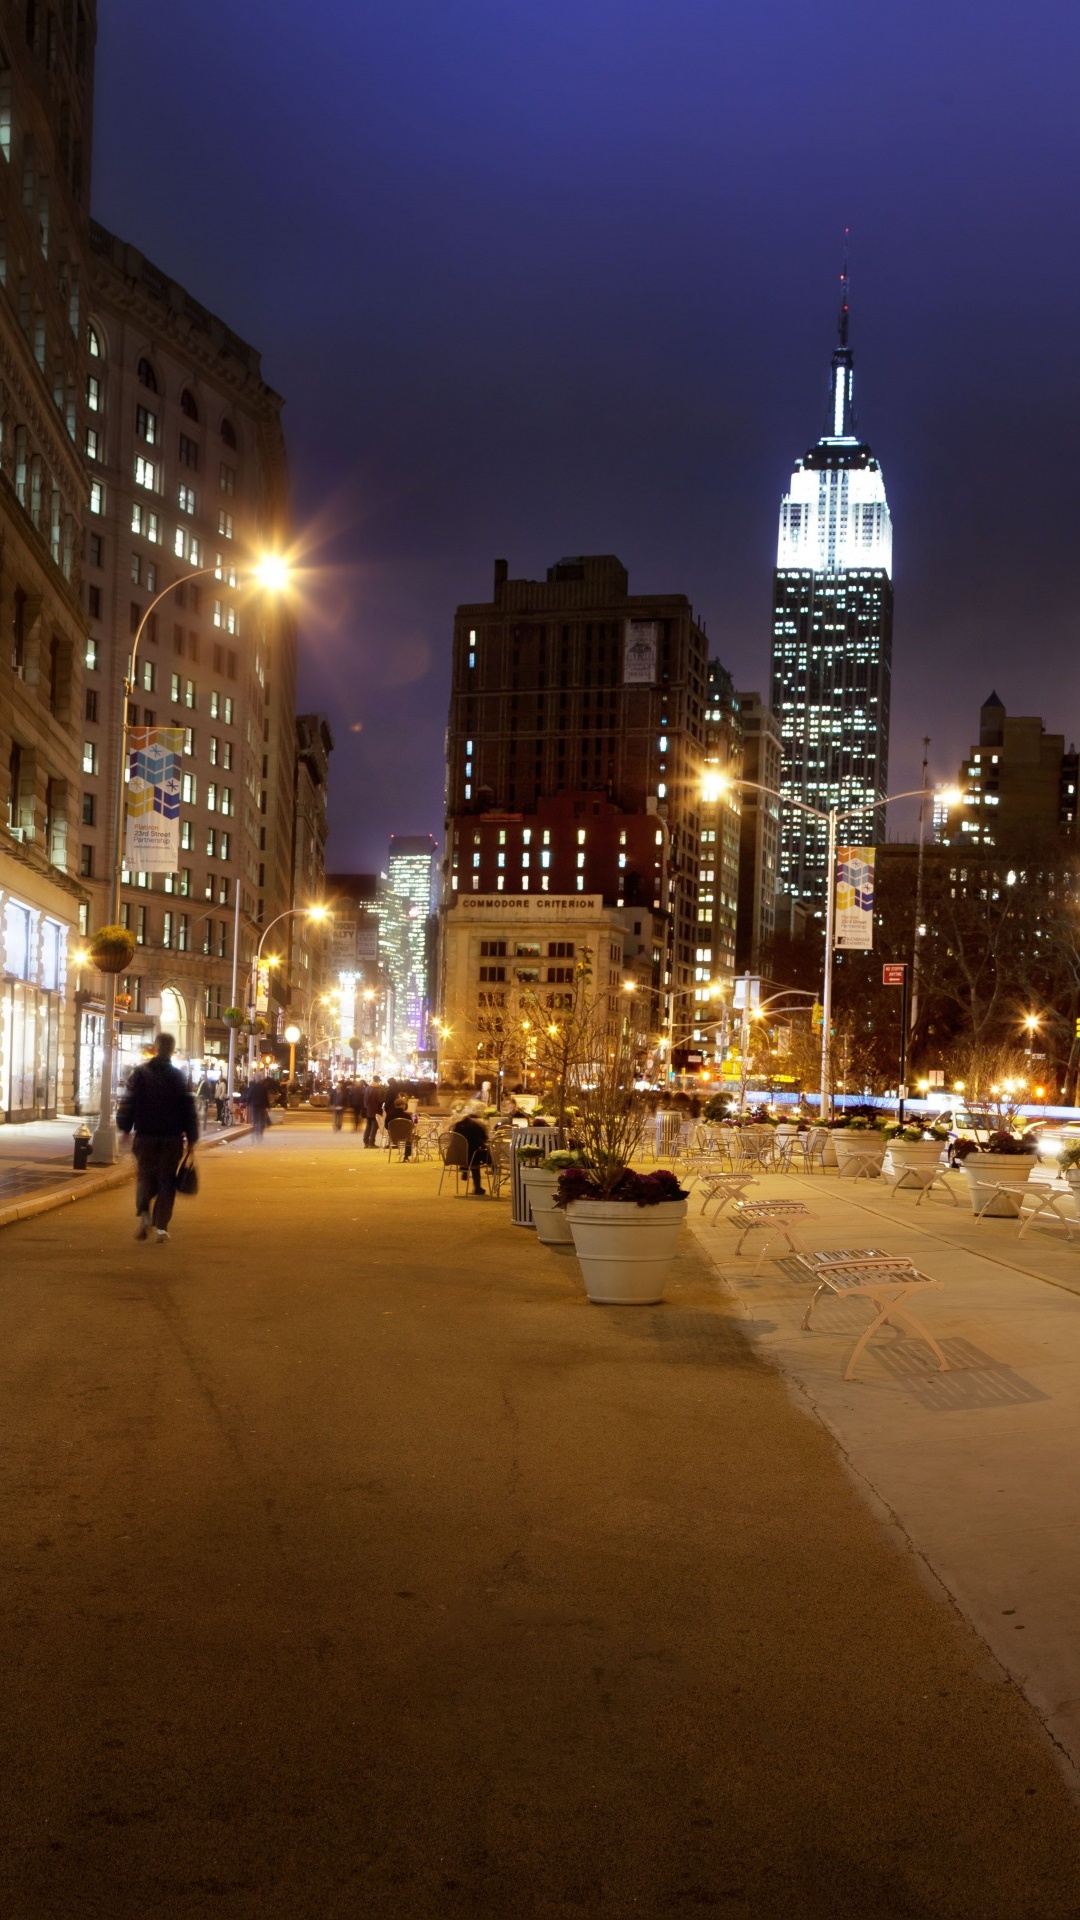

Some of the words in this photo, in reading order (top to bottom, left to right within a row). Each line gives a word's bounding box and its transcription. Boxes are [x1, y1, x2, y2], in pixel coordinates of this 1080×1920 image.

[134, 823, 160, 831] Flatiron
[150, 830, 171, 838] Street
[133, 837, 171, 845] Partnership
[462, 899, 530, 908] COMMODORE
[536, 899, 595, 908] CRITERION
